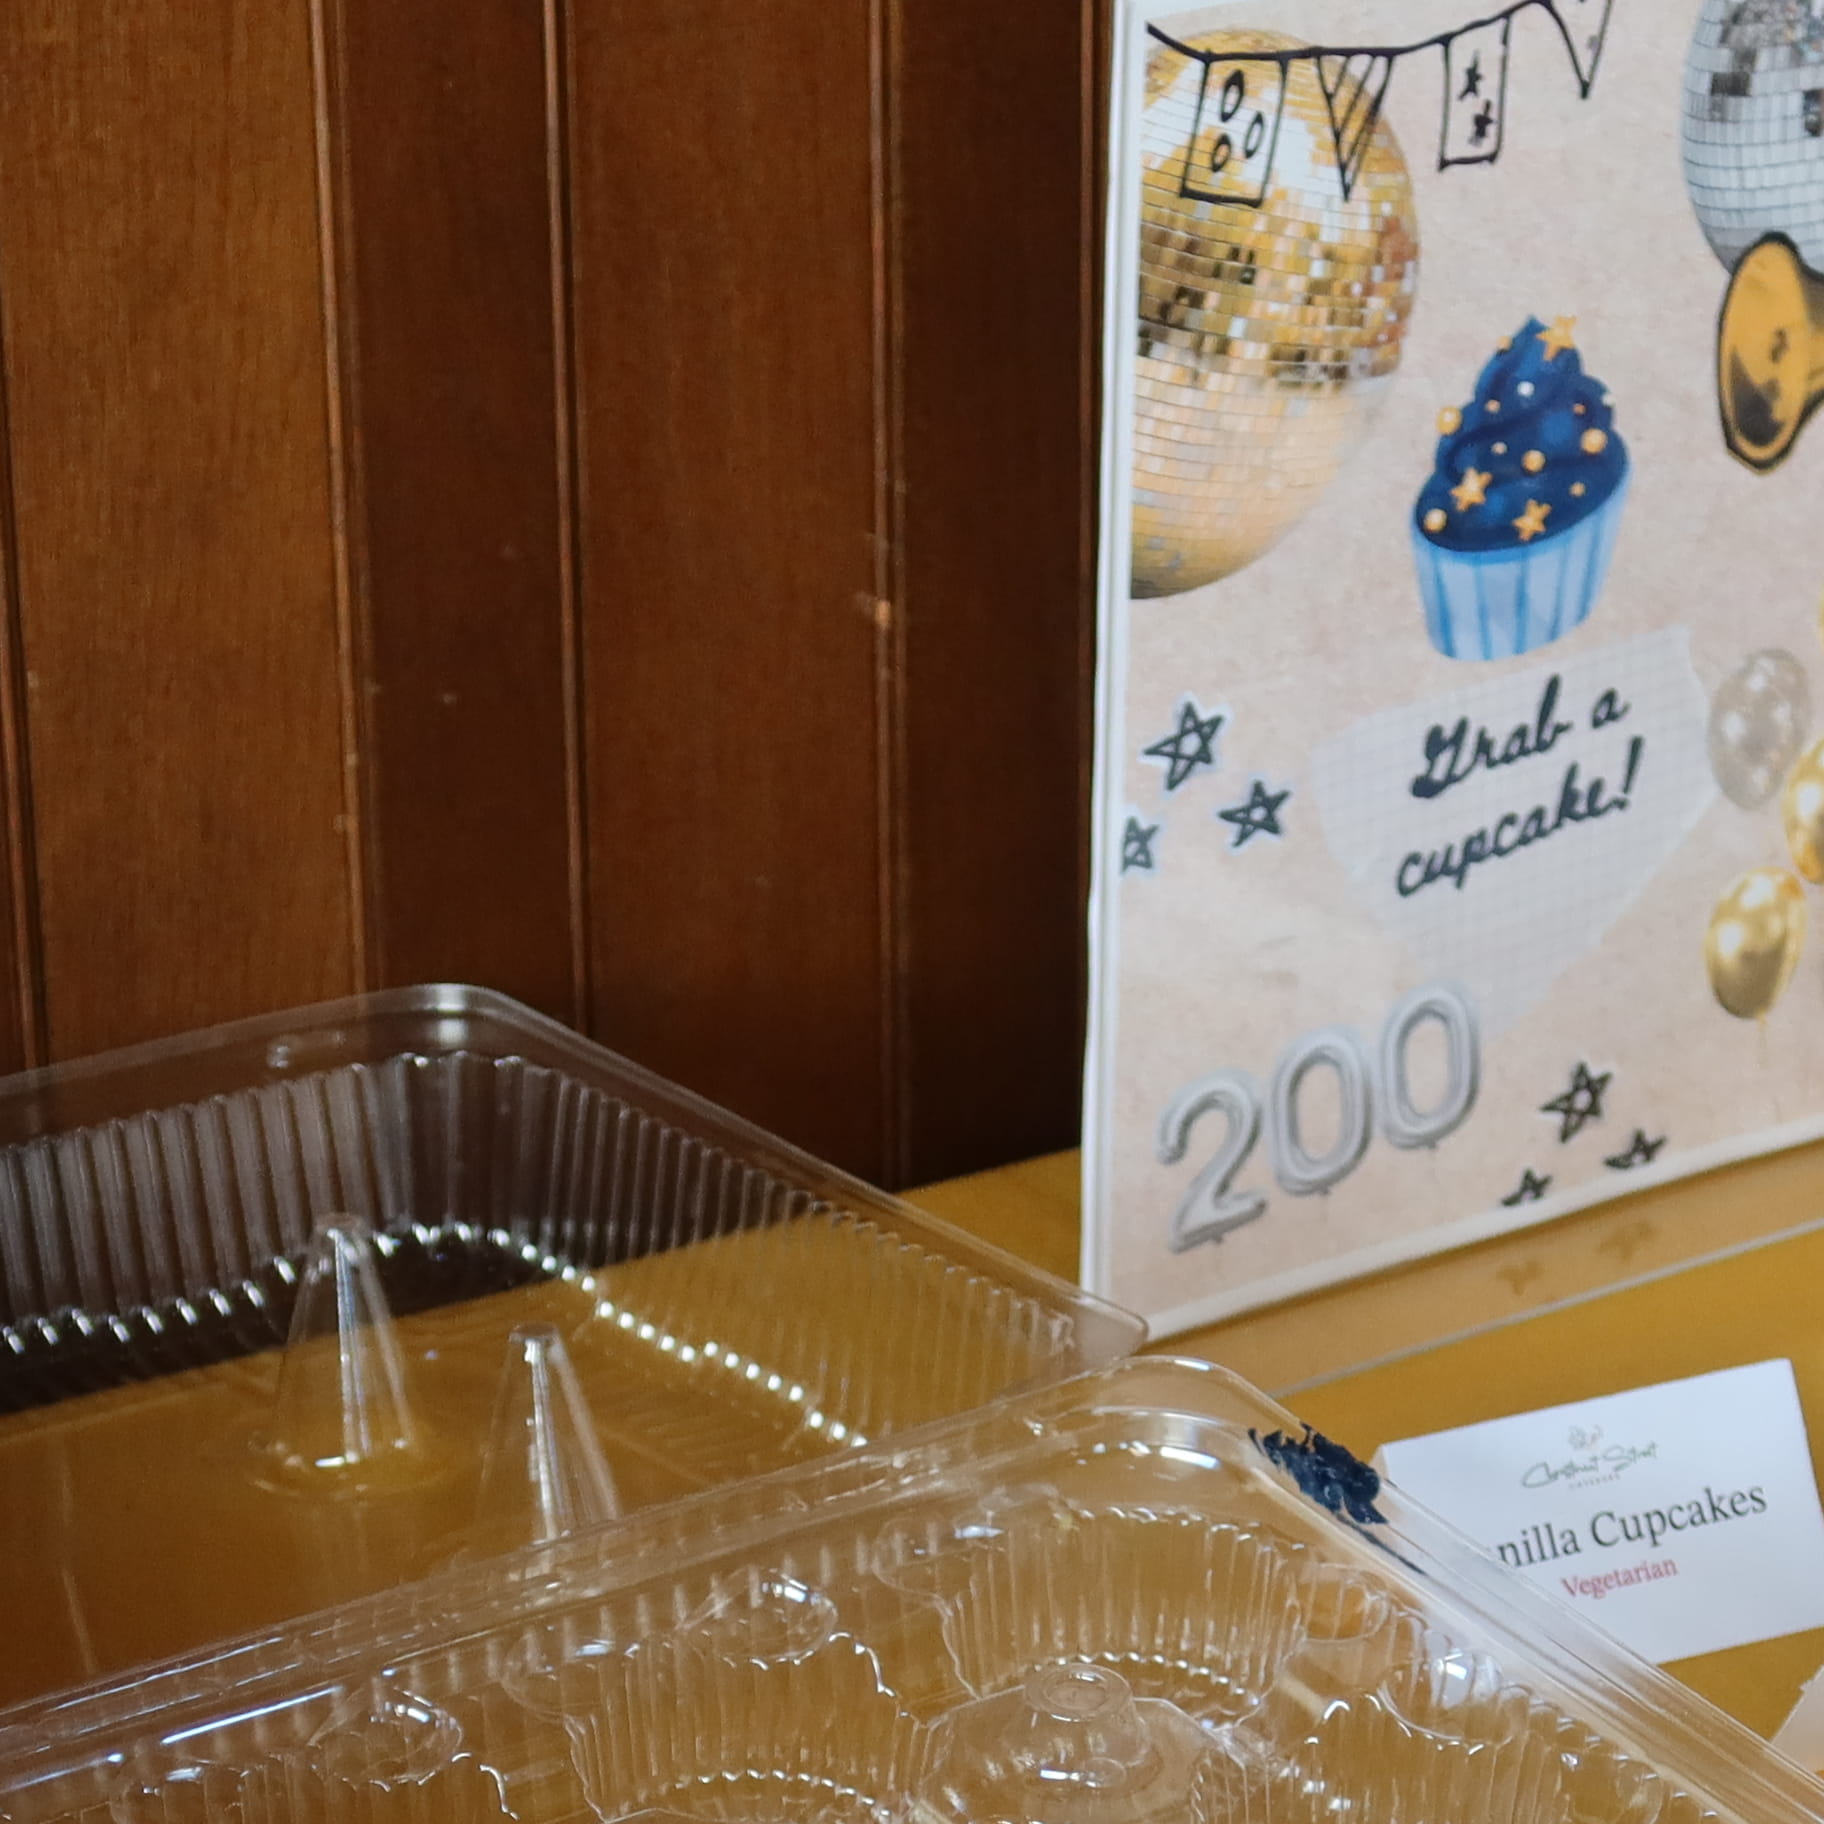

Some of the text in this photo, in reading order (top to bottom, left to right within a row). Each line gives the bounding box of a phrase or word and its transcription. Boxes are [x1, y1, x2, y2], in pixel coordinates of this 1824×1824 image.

[1410, 674, 1631, 798] Grab a
[1395, 738, 1645, 897] cupcake!
[1157, 983, 1481, 1253] 200
[1488, 1485, 1768, 1568] nilla Cupcakes
[1561, 1558, 1679, 1600] Vegetarian
